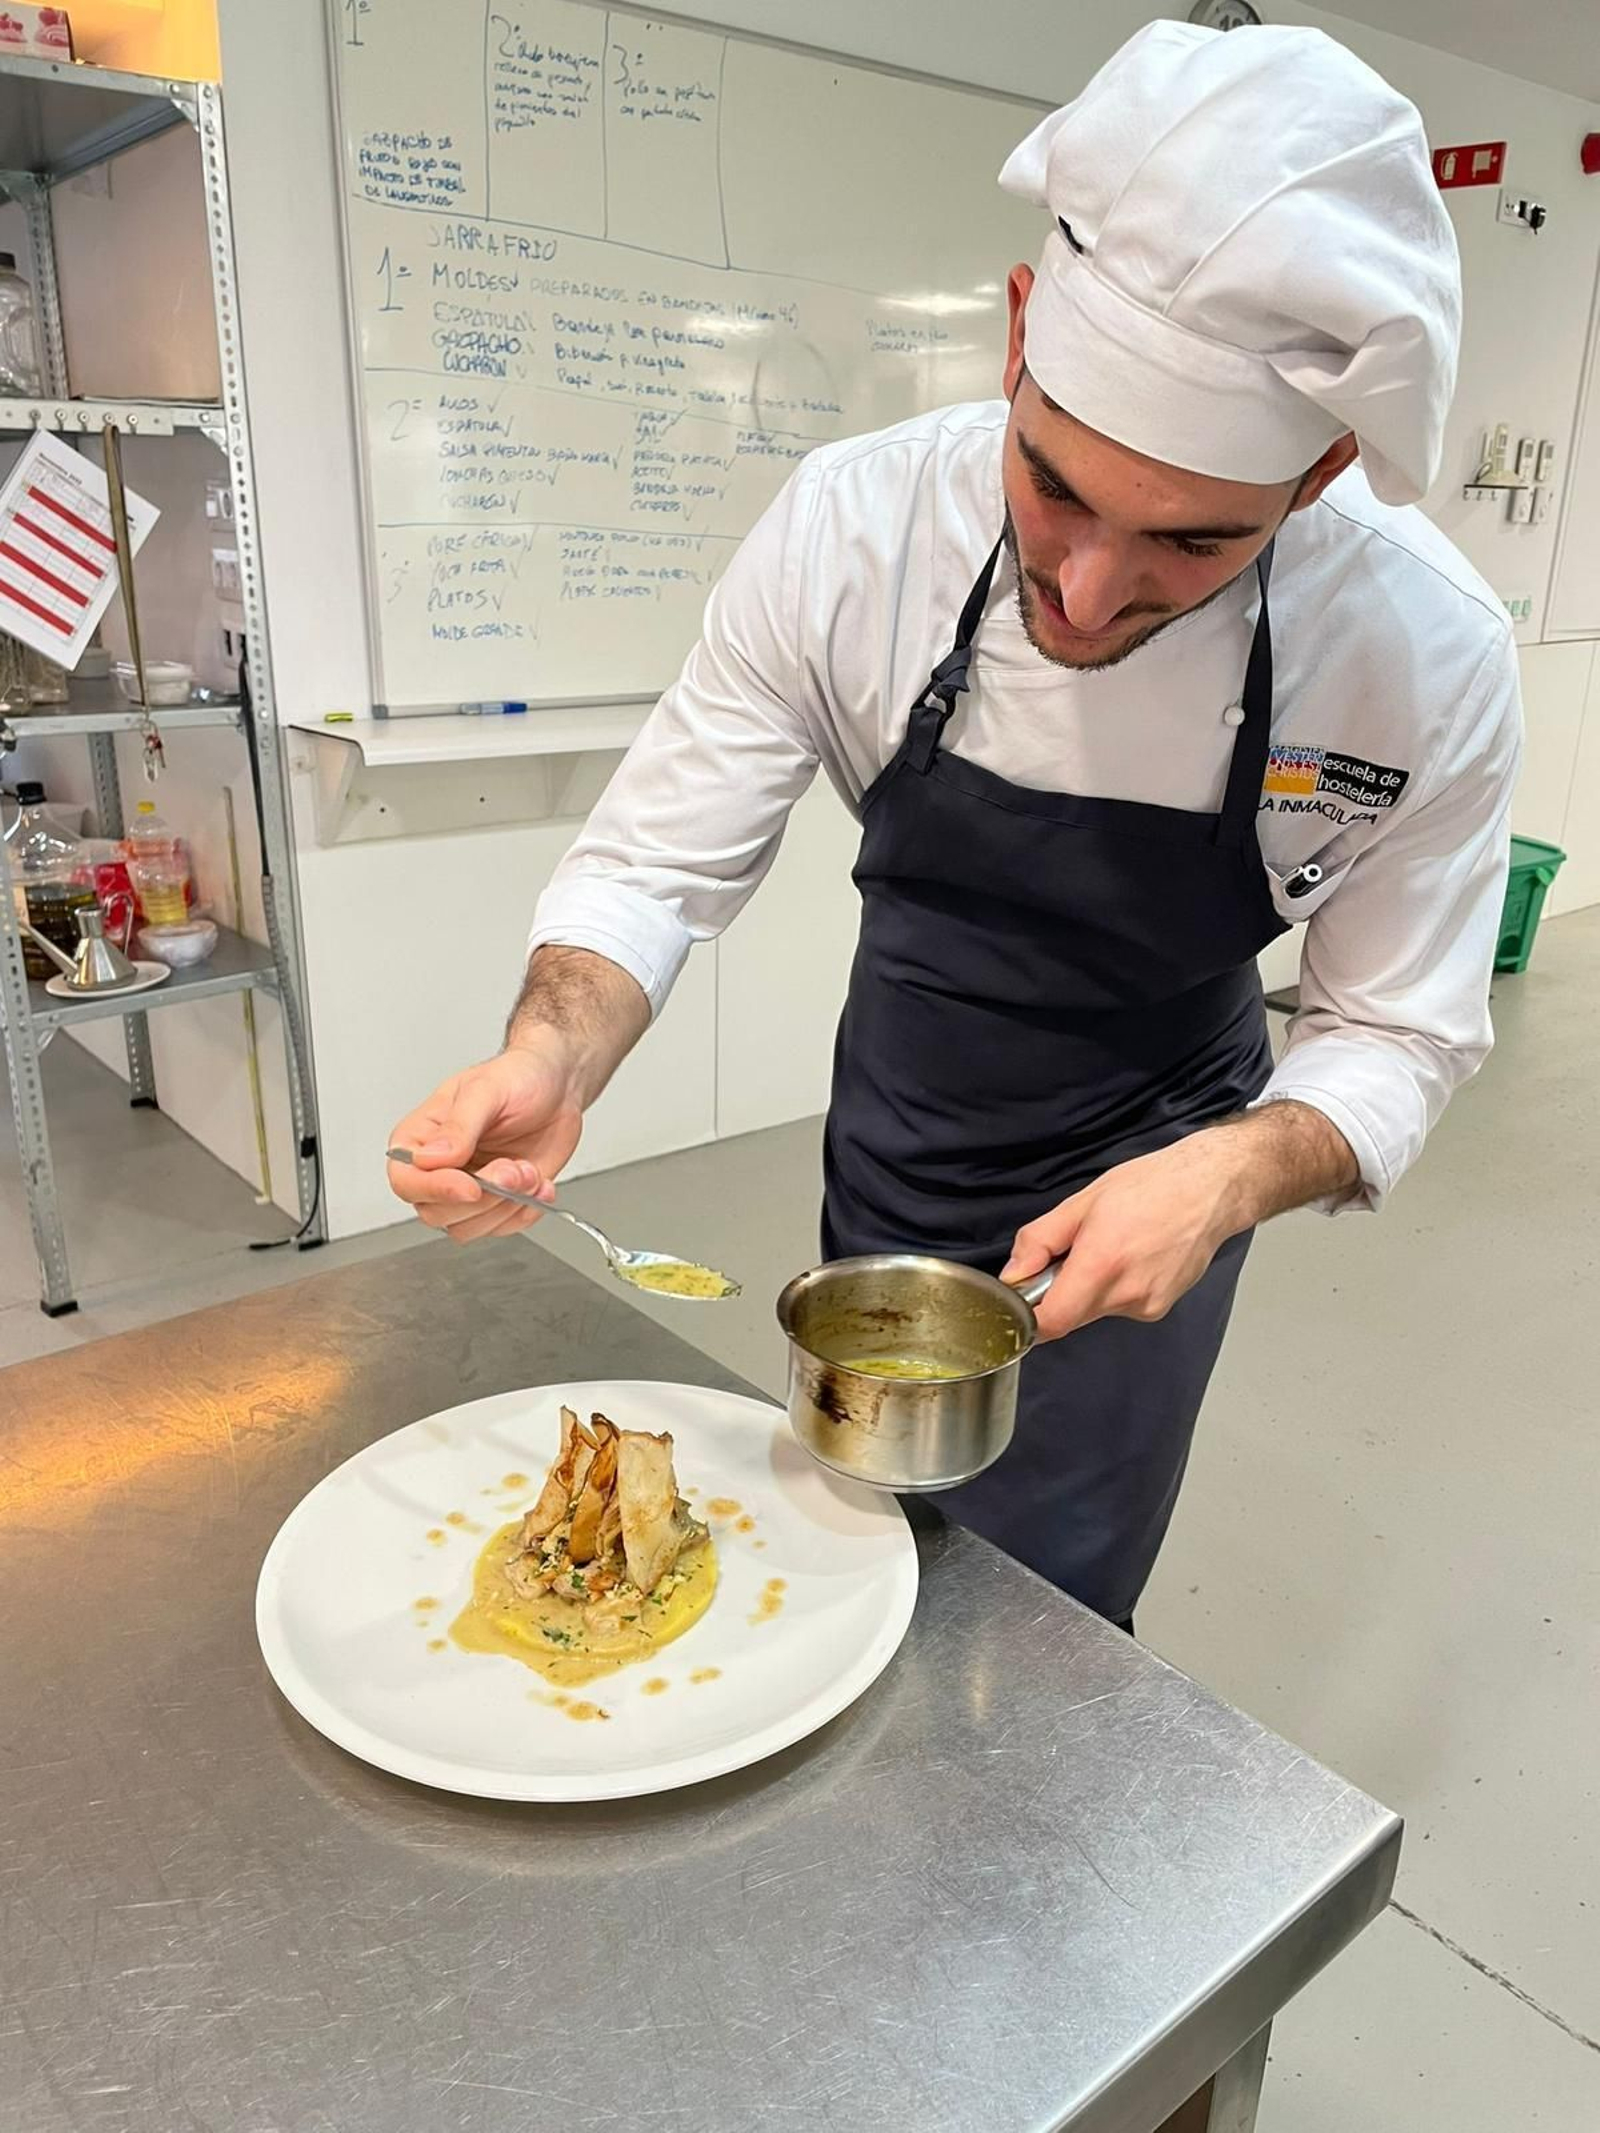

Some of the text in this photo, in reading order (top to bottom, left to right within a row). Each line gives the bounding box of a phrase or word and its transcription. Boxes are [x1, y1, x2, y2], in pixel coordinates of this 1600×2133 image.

[1323, 758, 1401, 787] escuela de
[1318, 773, 1393, 807] hostelería
